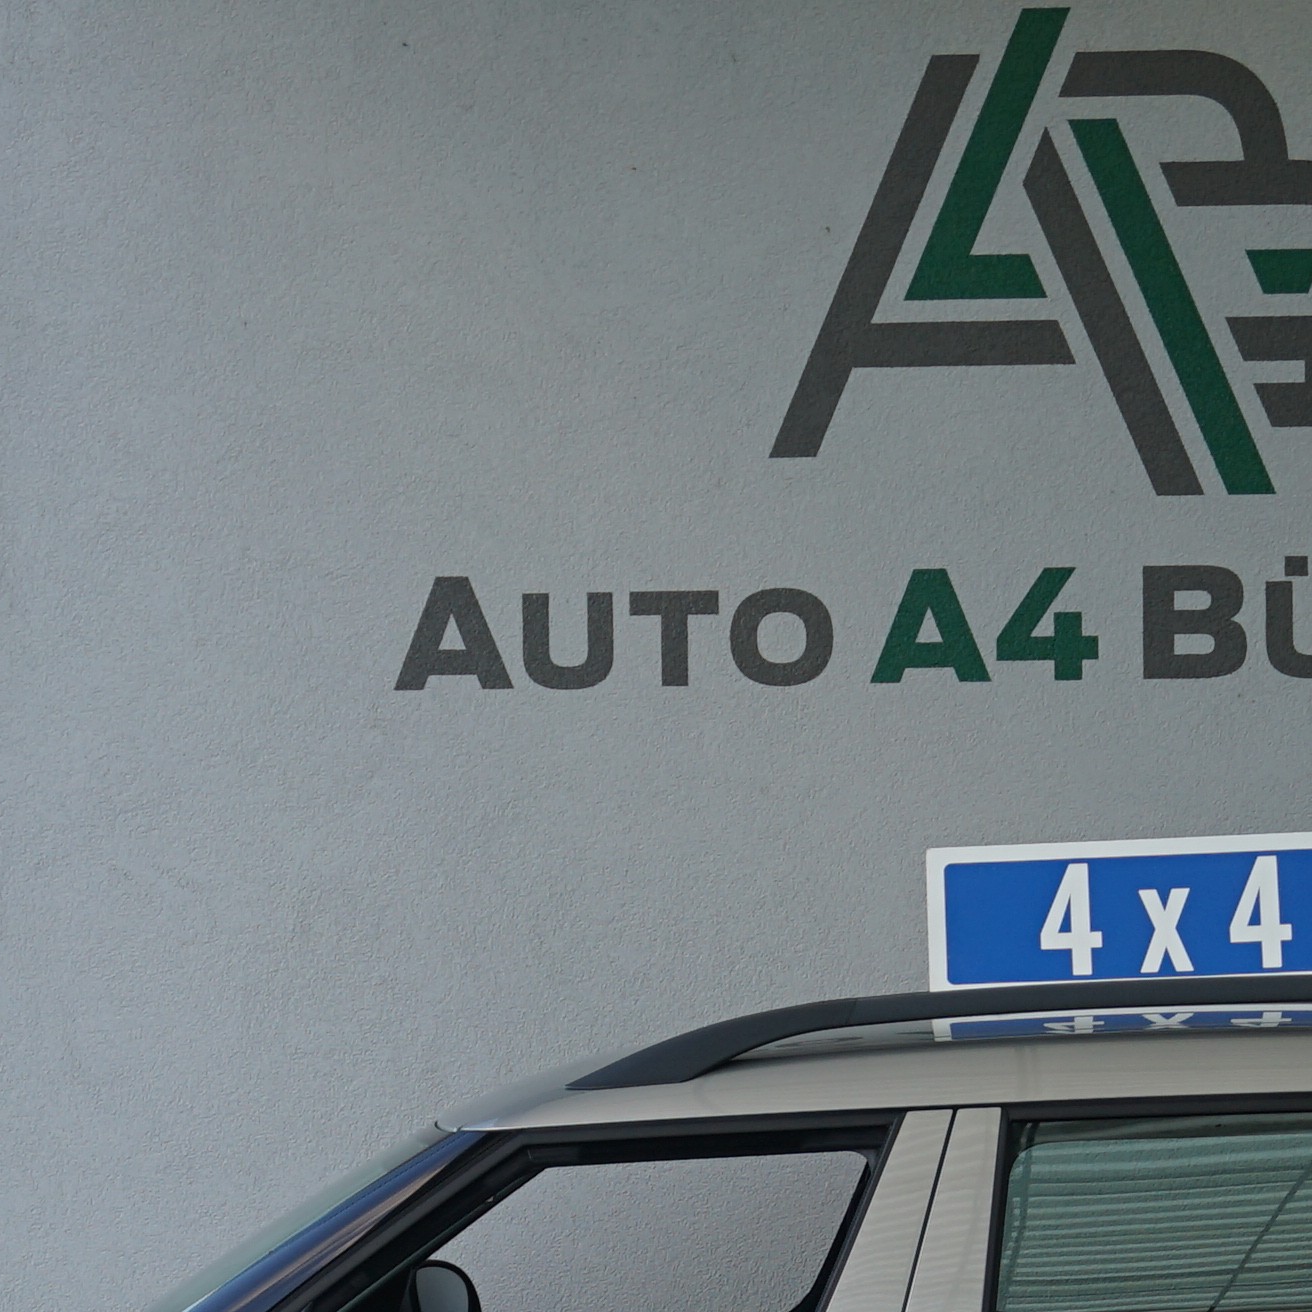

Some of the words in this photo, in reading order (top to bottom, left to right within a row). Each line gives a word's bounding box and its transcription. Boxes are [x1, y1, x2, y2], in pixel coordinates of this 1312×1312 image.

[394, 576, 834, 691] AUTO
[870, 566, 1099, 684] A4
[1040, 863, 1103, 976] 4
[1229, 855, 1293, 969] 4
